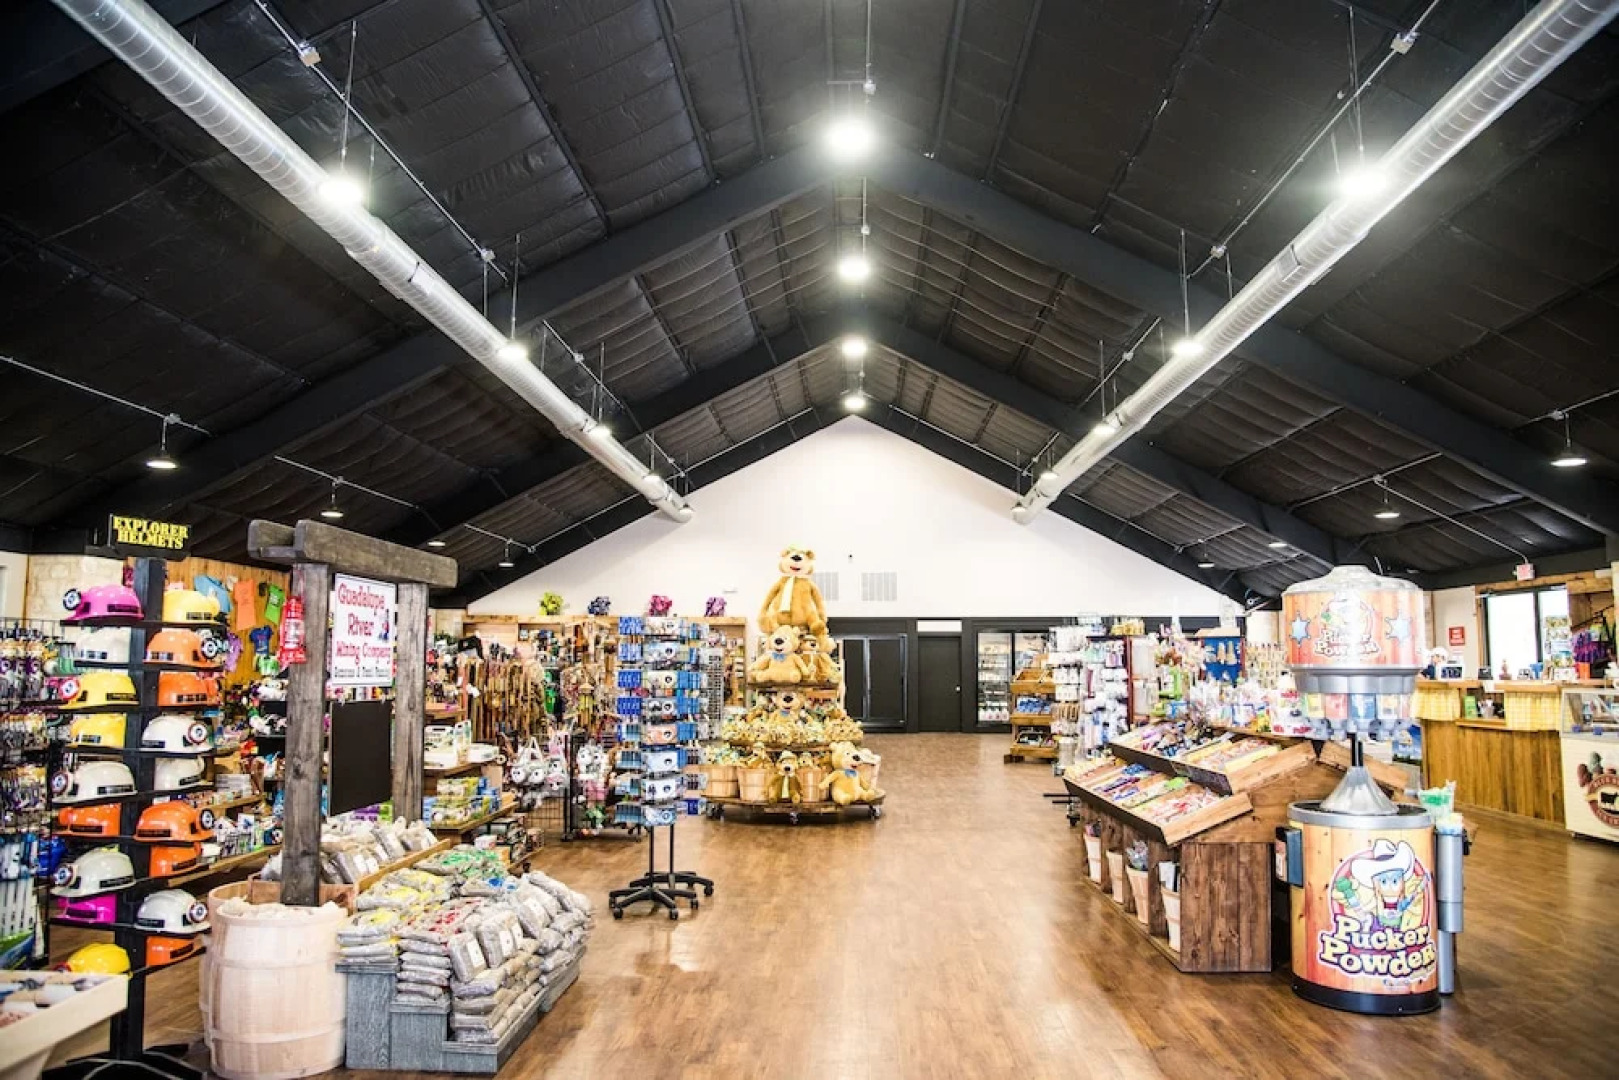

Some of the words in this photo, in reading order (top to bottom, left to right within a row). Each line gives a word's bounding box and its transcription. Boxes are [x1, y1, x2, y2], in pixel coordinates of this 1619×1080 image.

[113, 516, 189, 539] EXPLORER
[117, 529, 184, 549] HELMETS
[347, 612, 375, 636] River
[336, 640, 360, 666] Mining
[1333, 914, 1429, 951] Pucker
